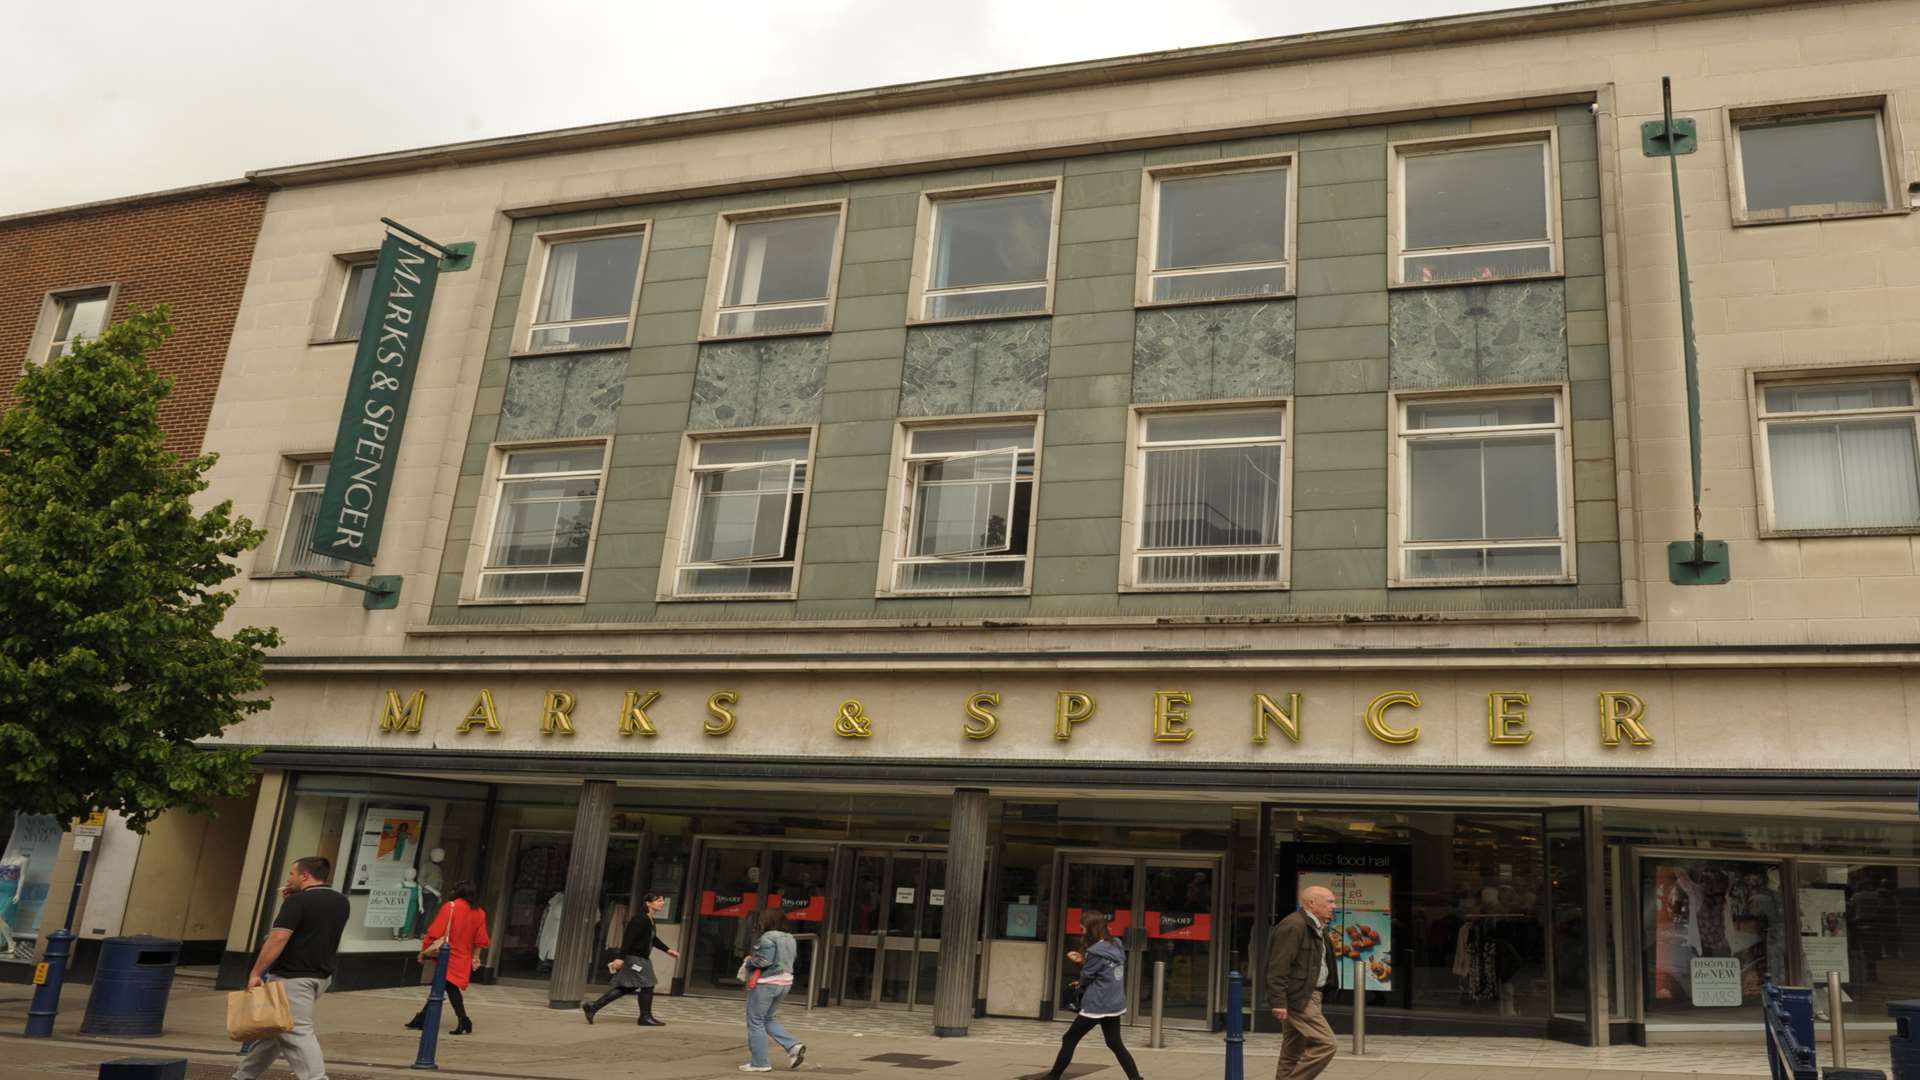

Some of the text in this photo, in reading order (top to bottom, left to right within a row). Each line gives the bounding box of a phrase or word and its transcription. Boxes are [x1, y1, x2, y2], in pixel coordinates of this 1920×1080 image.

[332, 247, 425, 549] MARKS & SPENCER
[379, 689, 1655, 745] MARKS & SPENCER
[1337, 855, 1366, 866] food
[1368, 856, 1390, 867] hall
[1694, 960, 1737, 969] DISCOVER
[1695, 969, 1735, 978] the NEW
